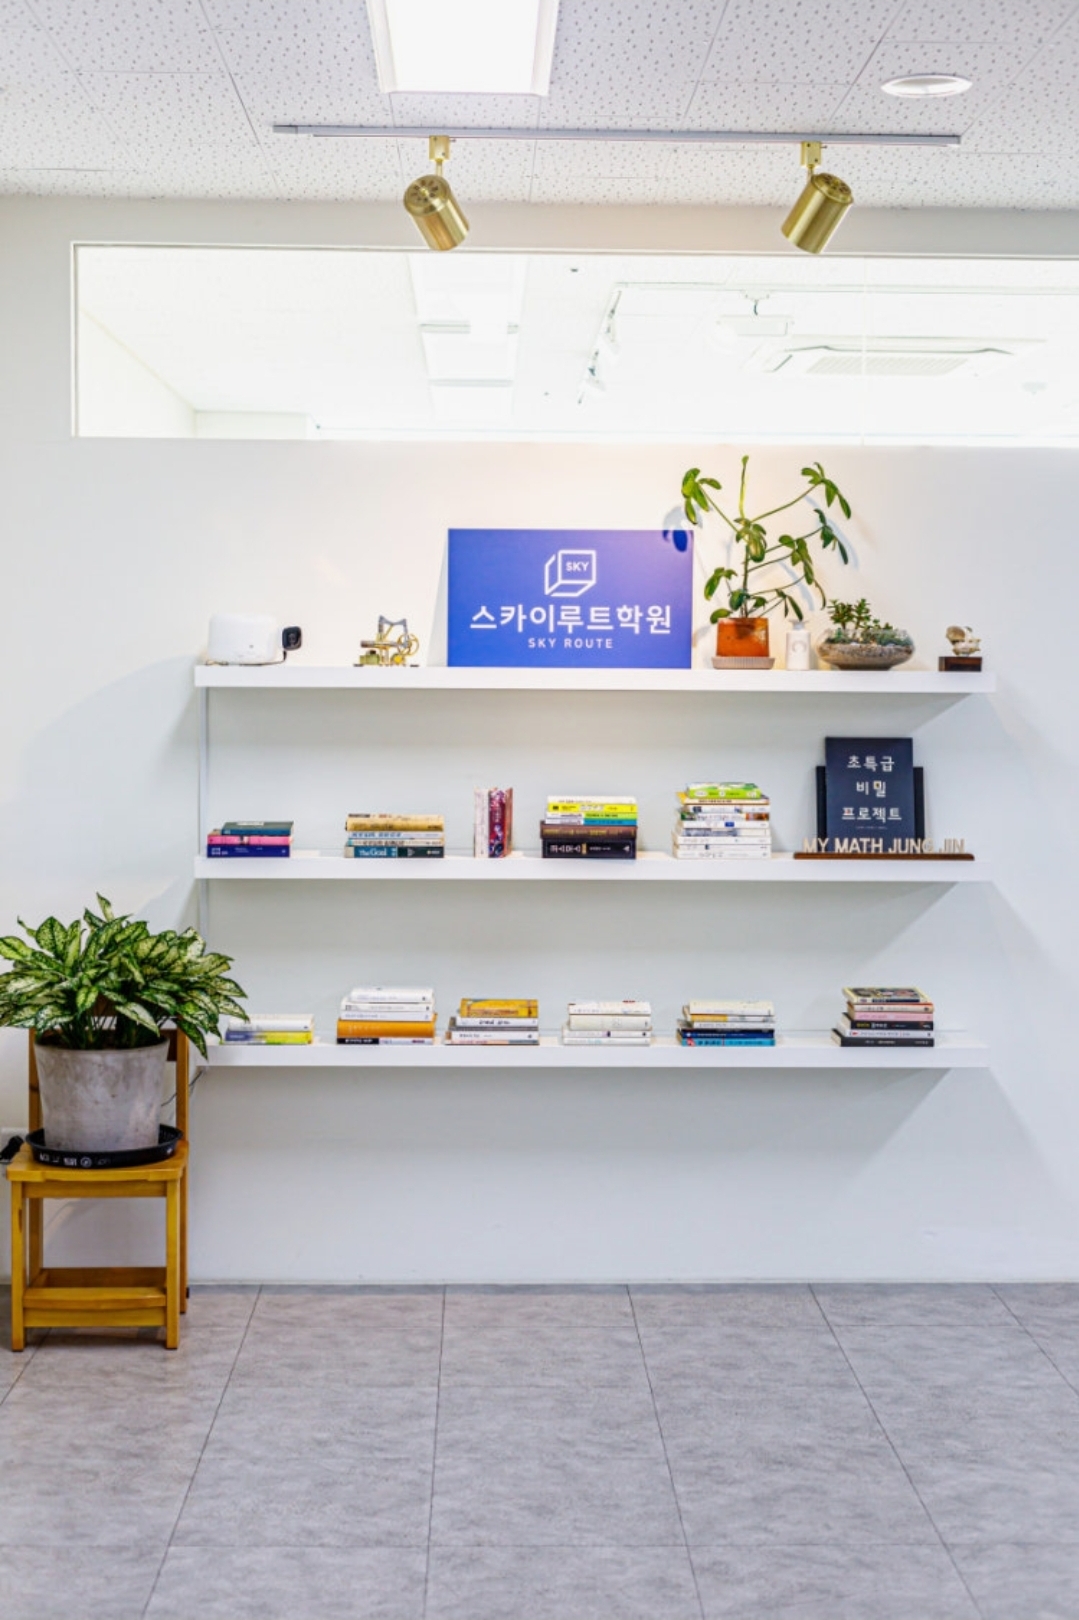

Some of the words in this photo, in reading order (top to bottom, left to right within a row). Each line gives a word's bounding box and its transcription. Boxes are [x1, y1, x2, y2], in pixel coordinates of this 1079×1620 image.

[566, 562, 588, 571] SKY
[470, 604, 671, 634] 스카이루트학원
[528, 638, 557, 648] SKY
[564, 638, 613, 648] ROUTE
[848, 755, 894, 771] 초특급
[856, 780, 887, 797] 비밀
[841, 807, 902, 823] 프로젝트
[370, 848, 387, 856] Goal
[803, 838, 830, 853] MY
[834, 838, 883, 853] MATH
[888, 838, 934, 853] JUNG
[939, 838, 965, 853] JIN
